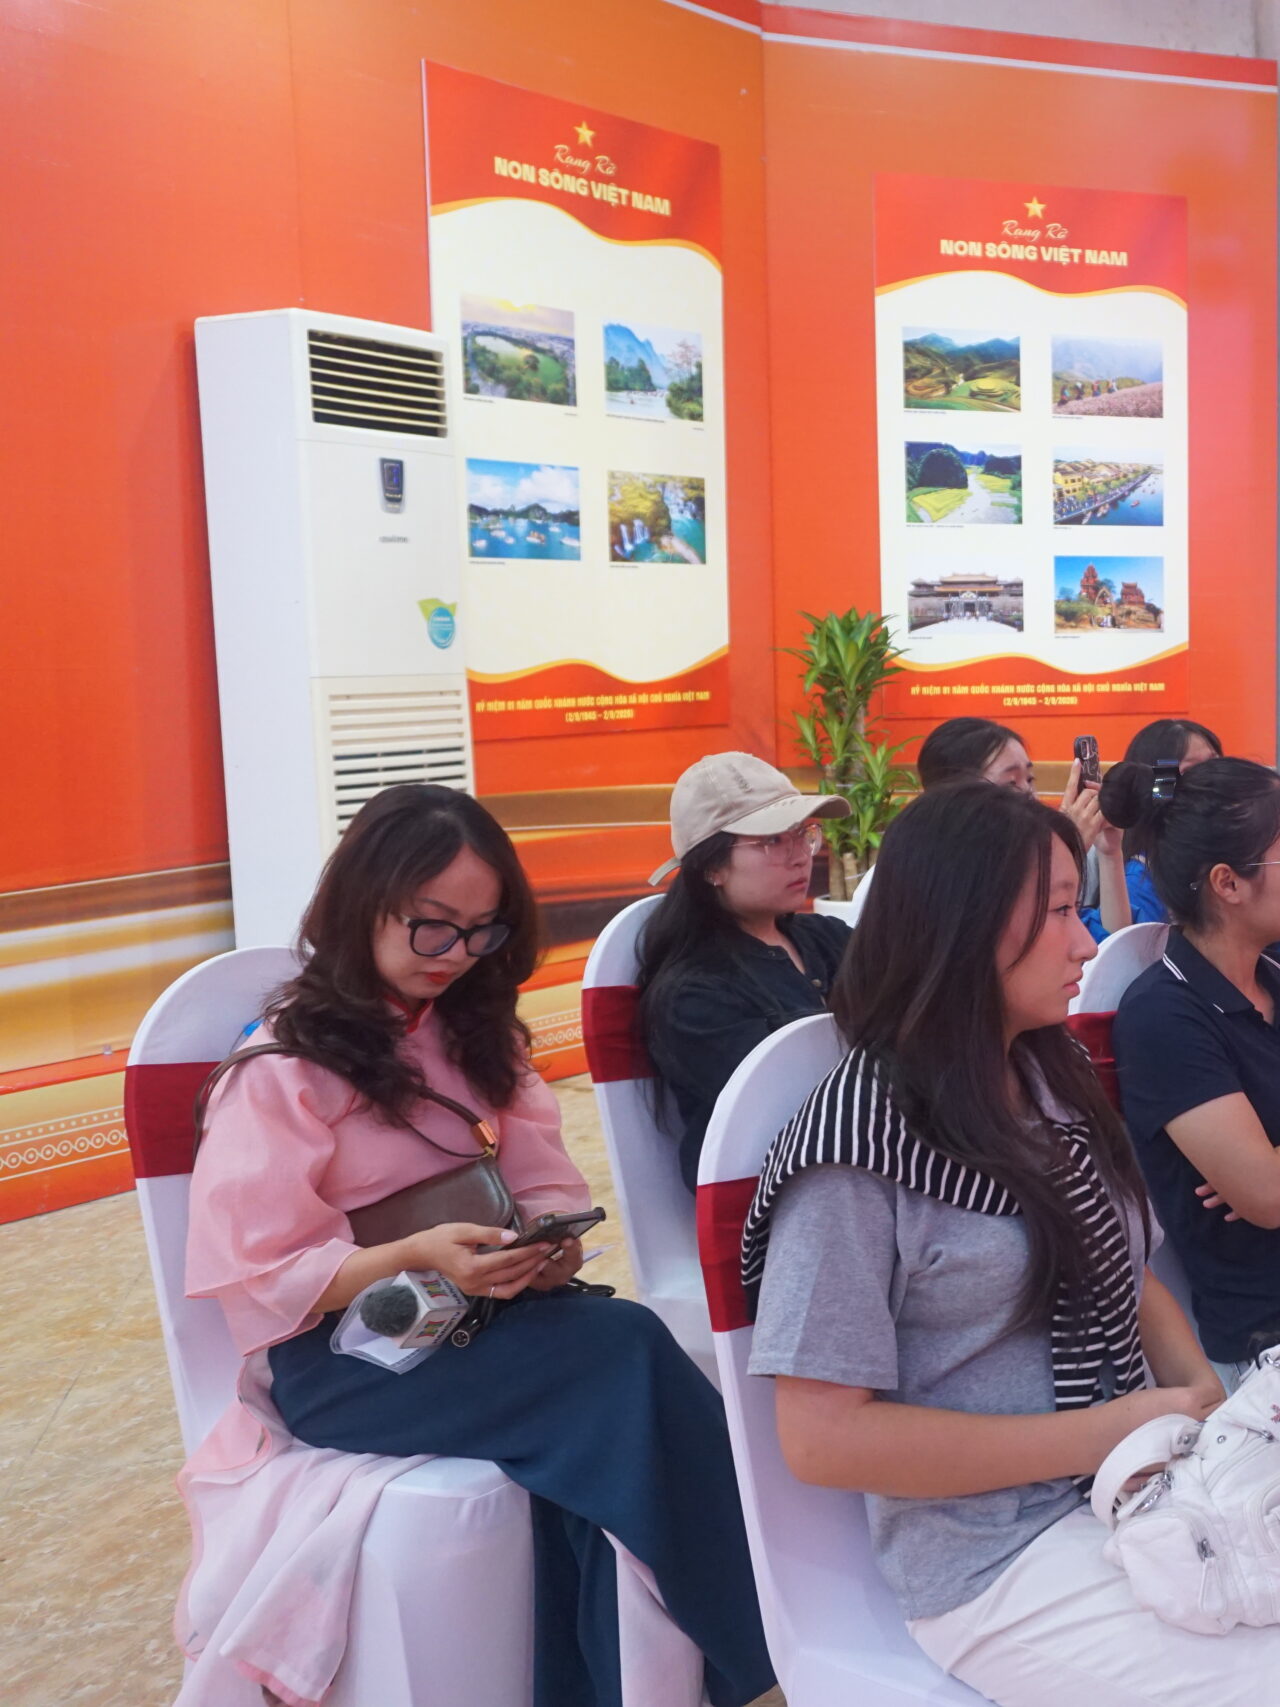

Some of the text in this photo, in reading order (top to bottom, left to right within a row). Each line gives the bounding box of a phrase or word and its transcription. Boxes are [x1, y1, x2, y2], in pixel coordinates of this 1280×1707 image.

[554, 144, 591, 174] Rạng
[493, 156, 671, 216] NON SÔNG VIỆT NAM
[1001, 219, 1042, 242] Rạng
[939, 239, 1128, 267] NON SÔNG VIỆT NAM
